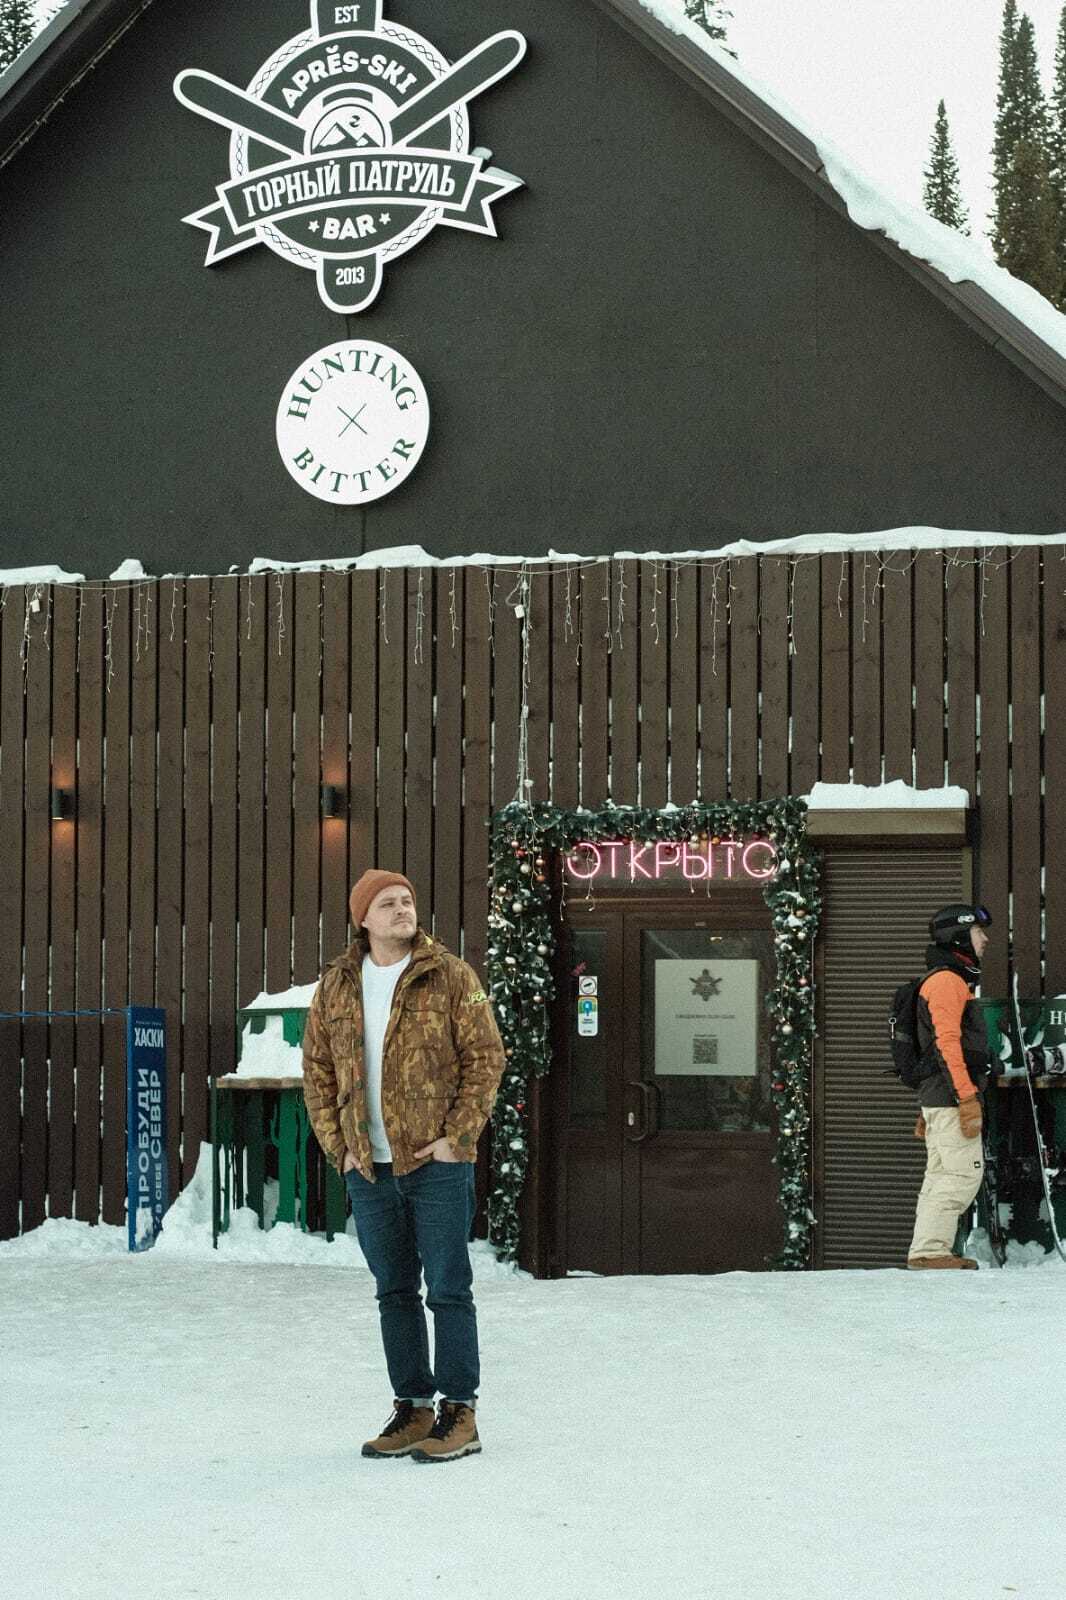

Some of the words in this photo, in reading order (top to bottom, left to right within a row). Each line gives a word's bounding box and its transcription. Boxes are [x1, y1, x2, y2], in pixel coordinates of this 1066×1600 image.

[334, 5, 361, 25] EST
[241, 159, 342, 218] ГОРНЫЙ
[348, 160, 457, 197] ПАТРУЛЬ
[322, 218, 377, 241] BAR
[335, 267, 366, 286] 2013
[287, 350, 418, 421] HUNTING
[293, 438, 416, 493] BITTER
[567, 841, 778, 879] ОТКРЫТО
[134, 1027, 164, 1048] ХАСКИ
[150, 1070, 161, 1159] СЕВЕР
